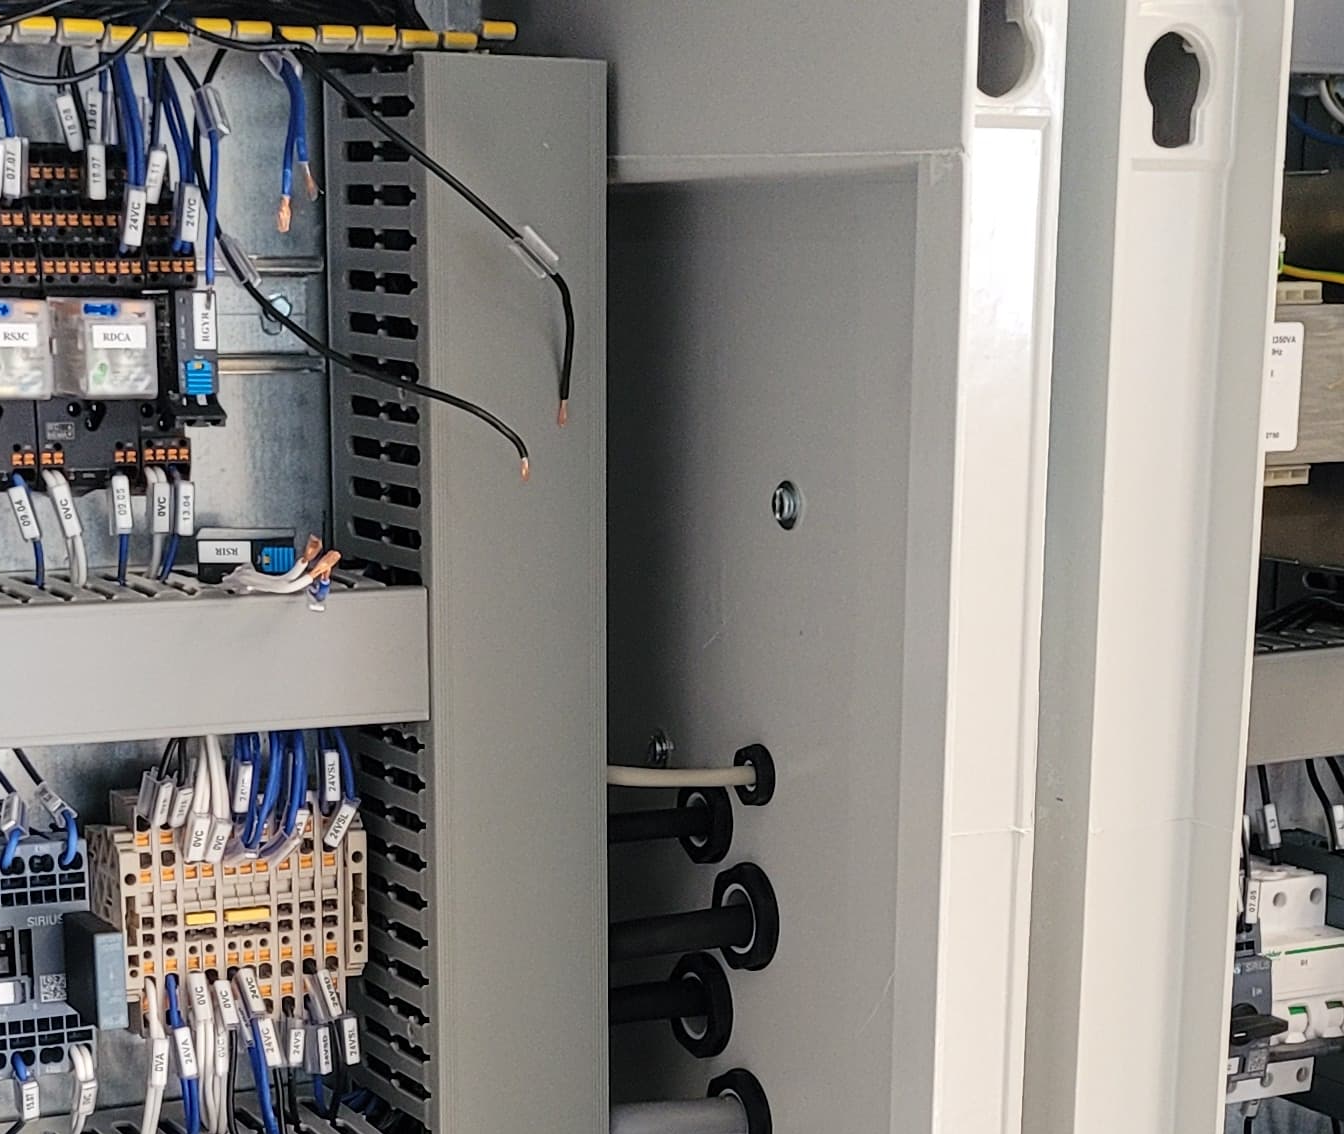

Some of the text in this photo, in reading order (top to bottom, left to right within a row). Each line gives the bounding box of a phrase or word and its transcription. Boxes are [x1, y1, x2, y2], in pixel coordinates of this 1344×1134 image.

[129, 201, 142, 231] 24VC
[103, 332, 131, 342] RDCA
[14, 499, 31, 526] 09.04
[60, 498, 73, 520] 0VC
[215, 547, 238, 556] RSIR
[331, 813, 349, 840] 24VSL
[193, 830, 203, 848] 0VC
[213, 835, 224, 851] 0VC
[27, 914, 64, 926] SIRIUS
[220, 991, 230, 1008] 0VC
[262, 1027, 274, 1053] 24VC
[180, 1038, 193, 1064] 24VA
